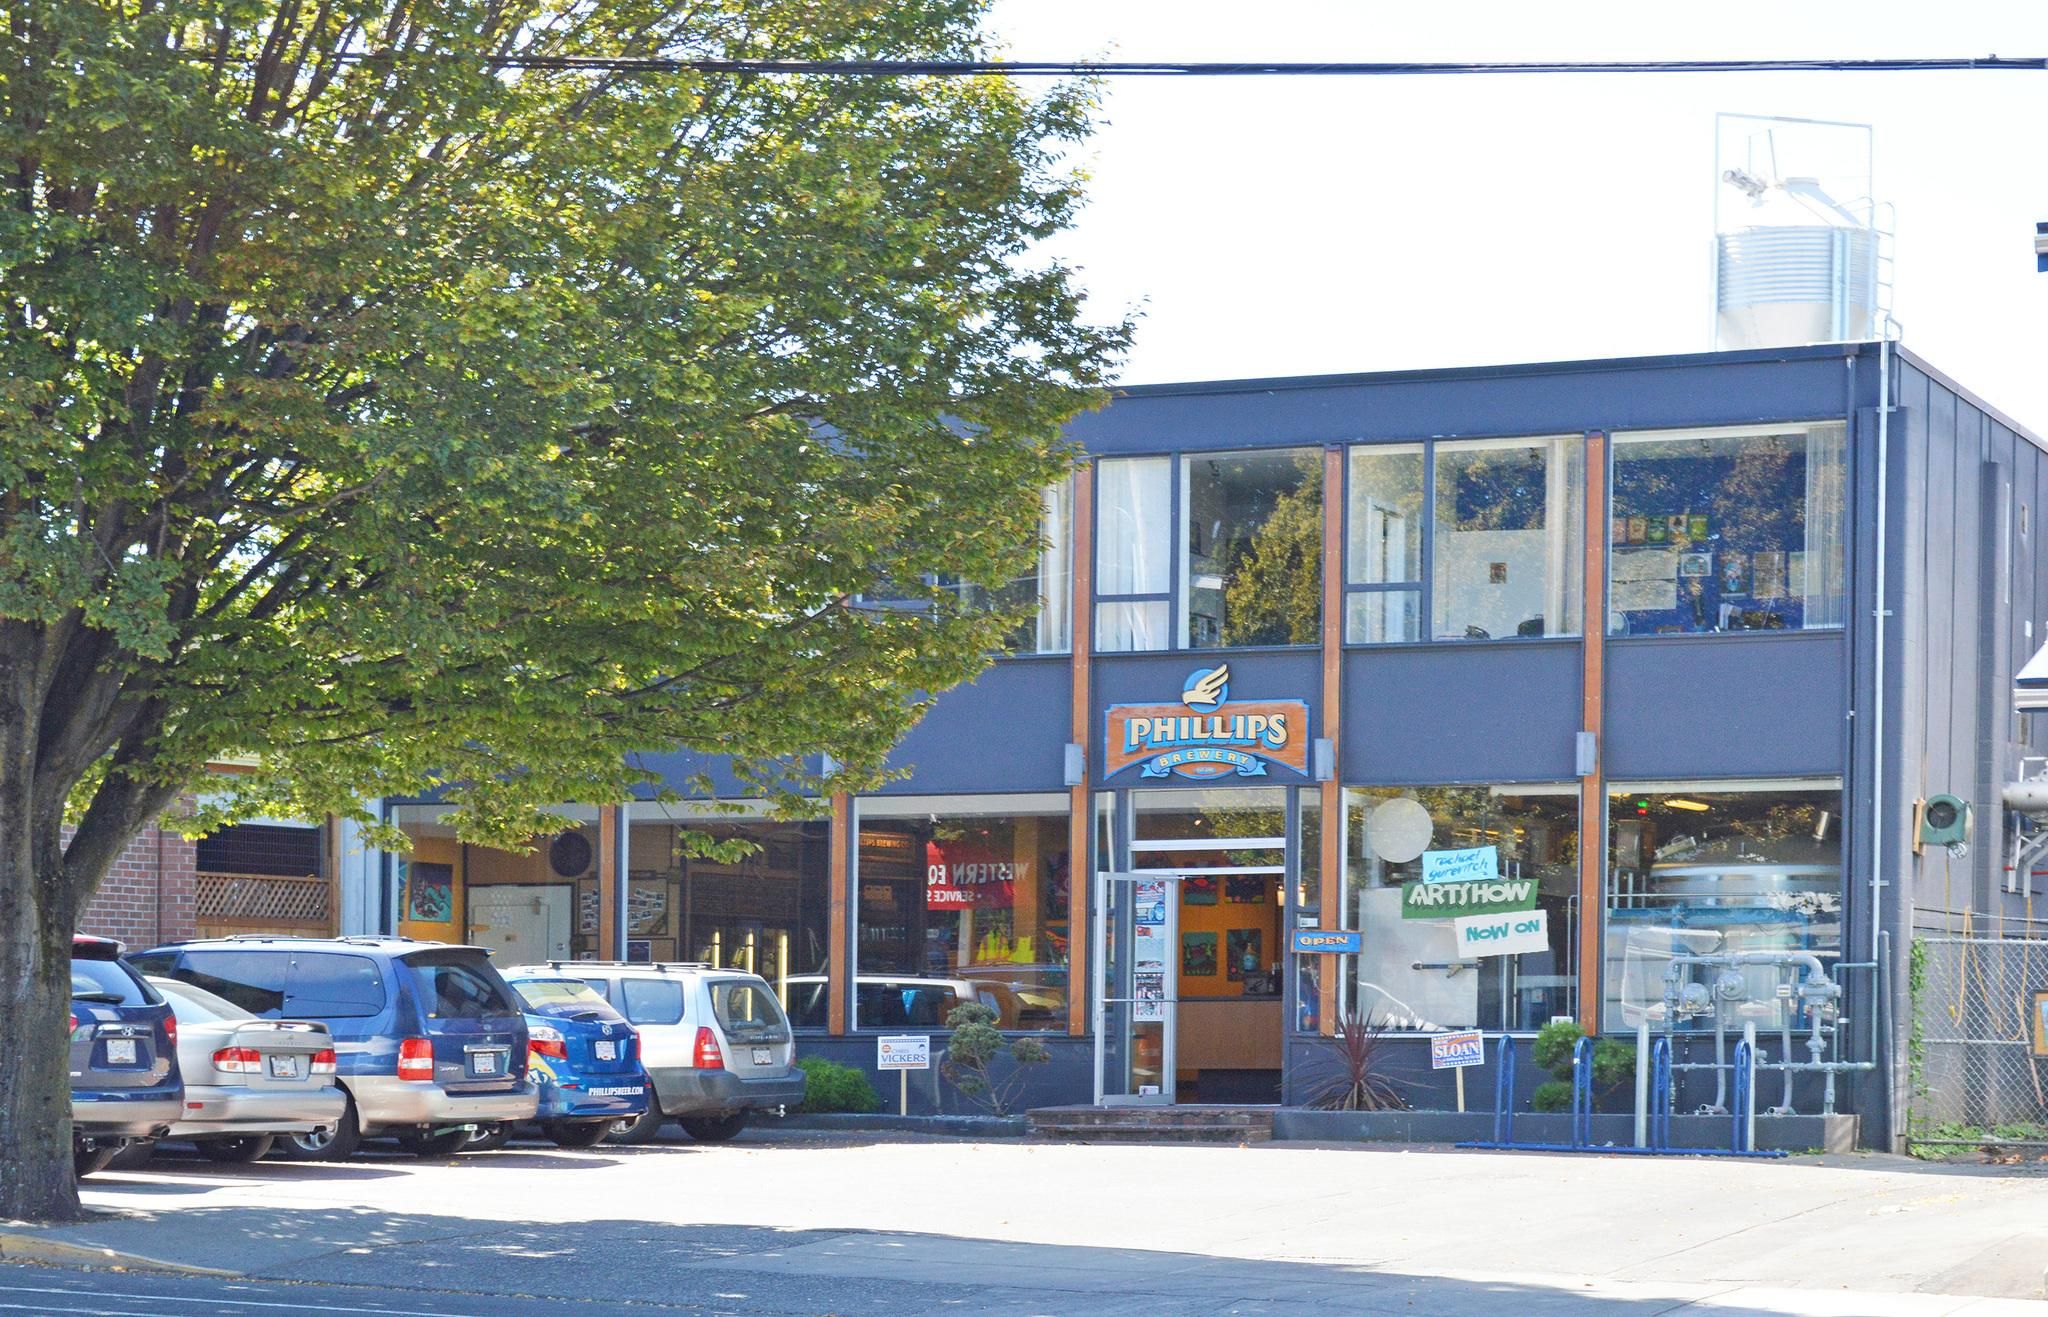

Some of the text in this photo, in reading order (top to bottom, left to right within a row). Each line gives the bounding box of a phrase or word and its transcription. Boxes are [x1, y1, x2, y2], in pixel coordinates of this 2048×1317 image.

[1127, 713, 1288, 750] PHILLIPS
[1158, 750, 1249, 767] BREWERY
[1465, 920, 1540, 941] NOW ON
[1299, 935, 1348, 946] OPEN
[880, 1053, 926, 1063] VICKERS
[1434, 1041, 1480, 1058] SLOAN
